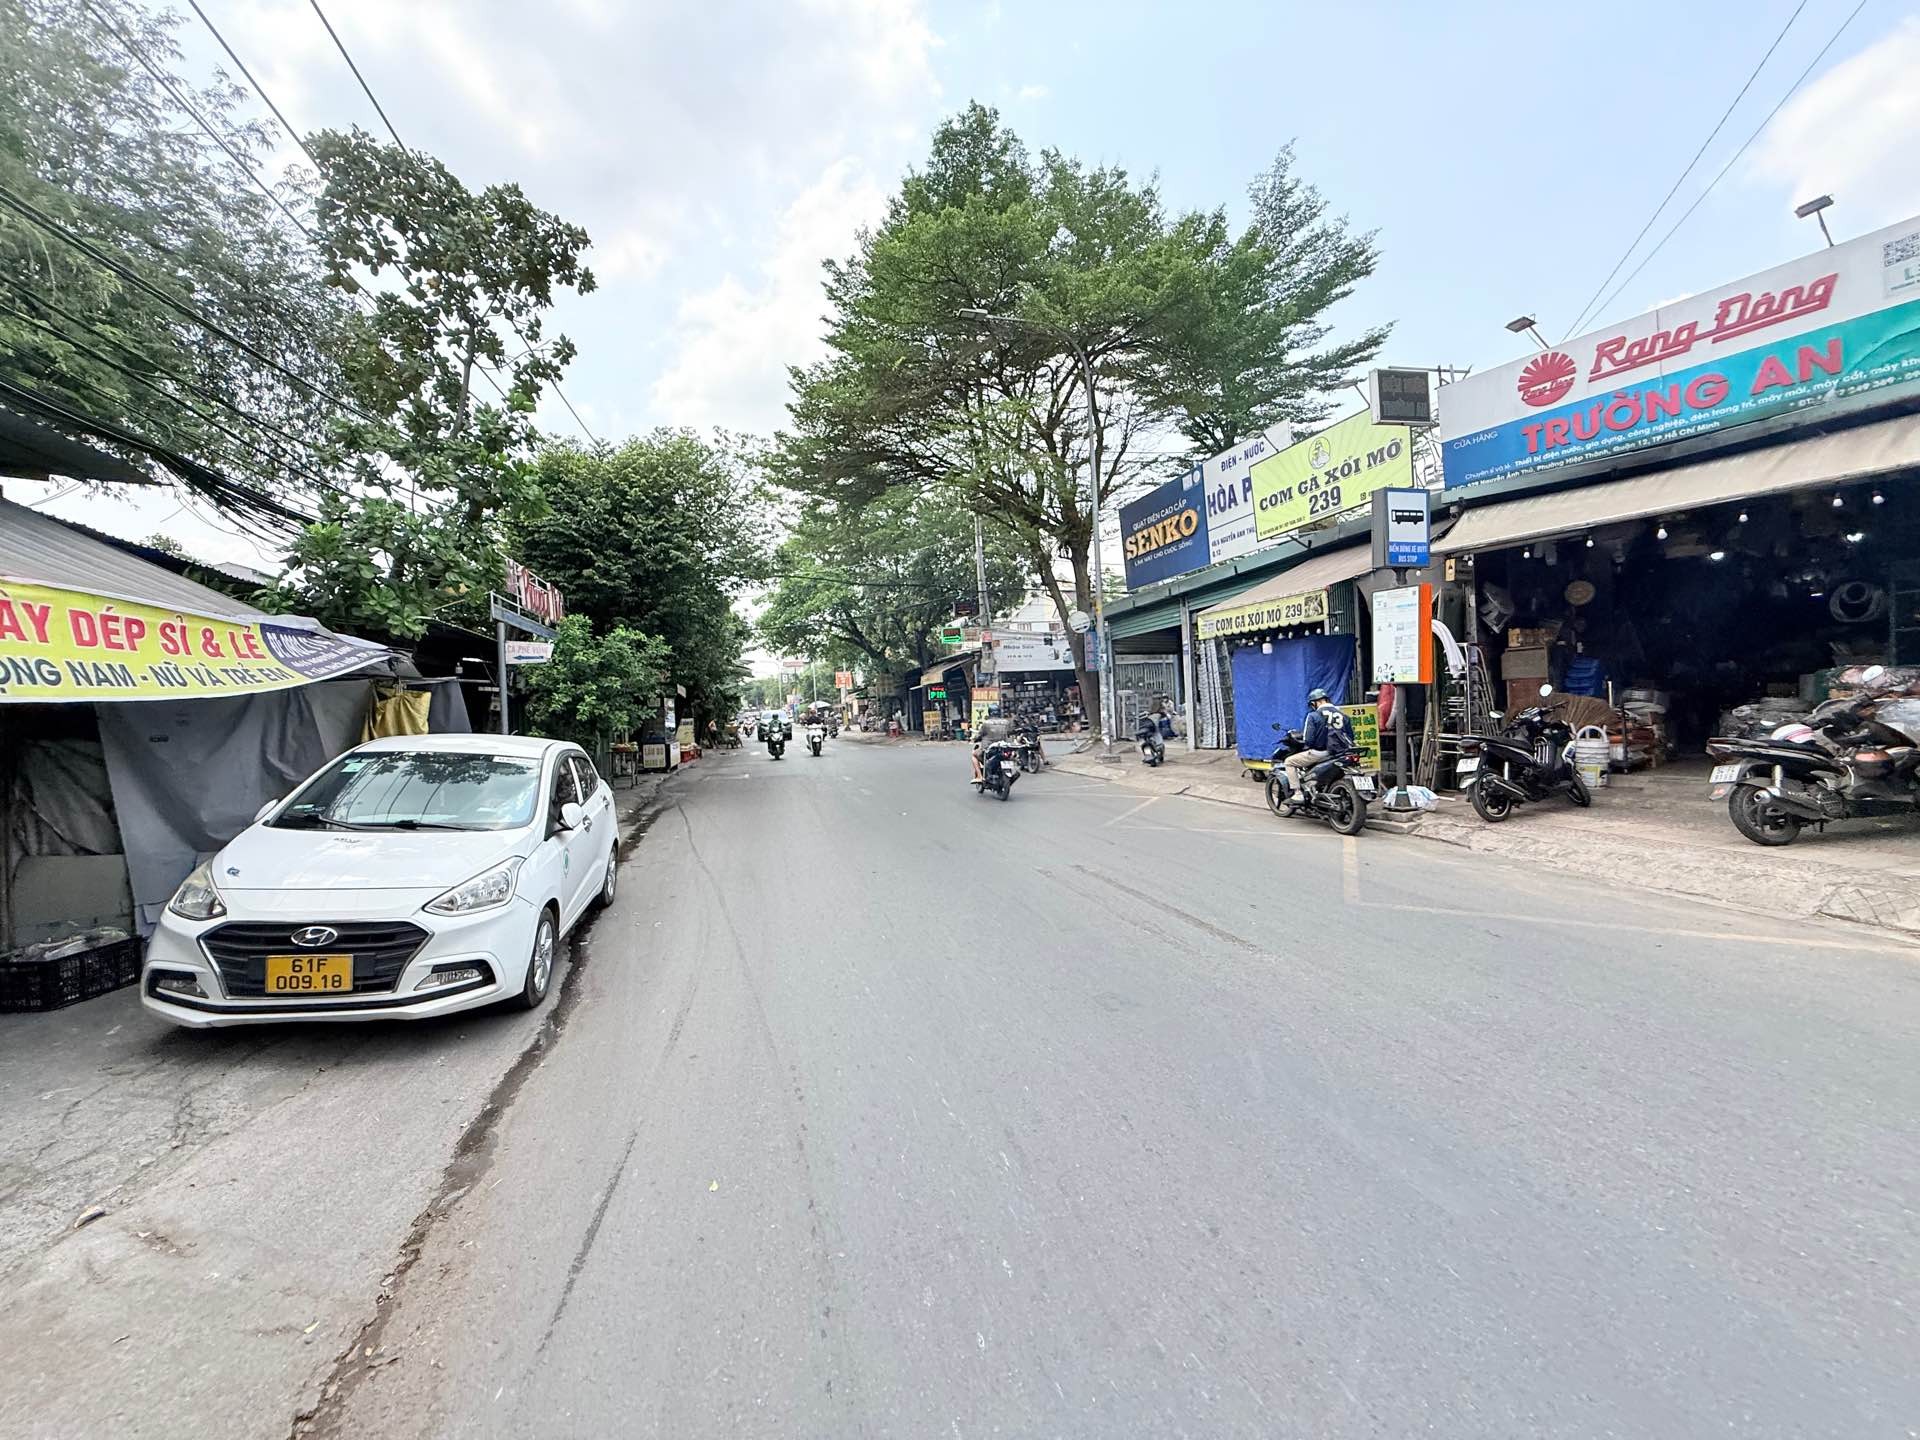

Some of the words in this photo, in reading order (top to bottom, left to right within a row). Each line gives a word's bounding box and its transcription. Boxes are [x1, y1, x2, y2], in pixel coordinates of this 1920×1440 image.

[1521, 372, 1729, 454] TRƯỜNG
[1750, 336, 1842, 396] AN
[1712, 403, 1740, 417] trang
[1757, 392, 1783, 406] máy
[1812, 378, 1839, 391] máy
[1472, 430, 1499, 445] HÀNG
[1565, 455, 1584, 465] Hiệp
[1696, 420, 1720, 432] Minh
[1220, 455, 1237, 473] ĐIỆN
[1297, 472, 1320, 495] GÀ
[1206, 483, 1239, 517] HÒA
[1308, 484, 1341, 516] 239
[1125, 508, 1198, 560] SENKO
[1285, 603, 1303, 618] 239
[68, 605, 146, 651] DÉP
[158, 615, 192, 656] SỈ
[201, 627, 226, 658] &
[228, 625, 266, 659] LẺ
[64, 660, 137, 687] NAM
[148, 660, 188, 687] NỮ
[184, 661, 227, 687] VÀ
[219, 661, 264, 685] TRẺ
[255, 667, 295, 682] EM
[1322, 710, 1344, 730] 73
[292, 958, 328, 973] 61F
[276, 974, 342, 990] 009.18
